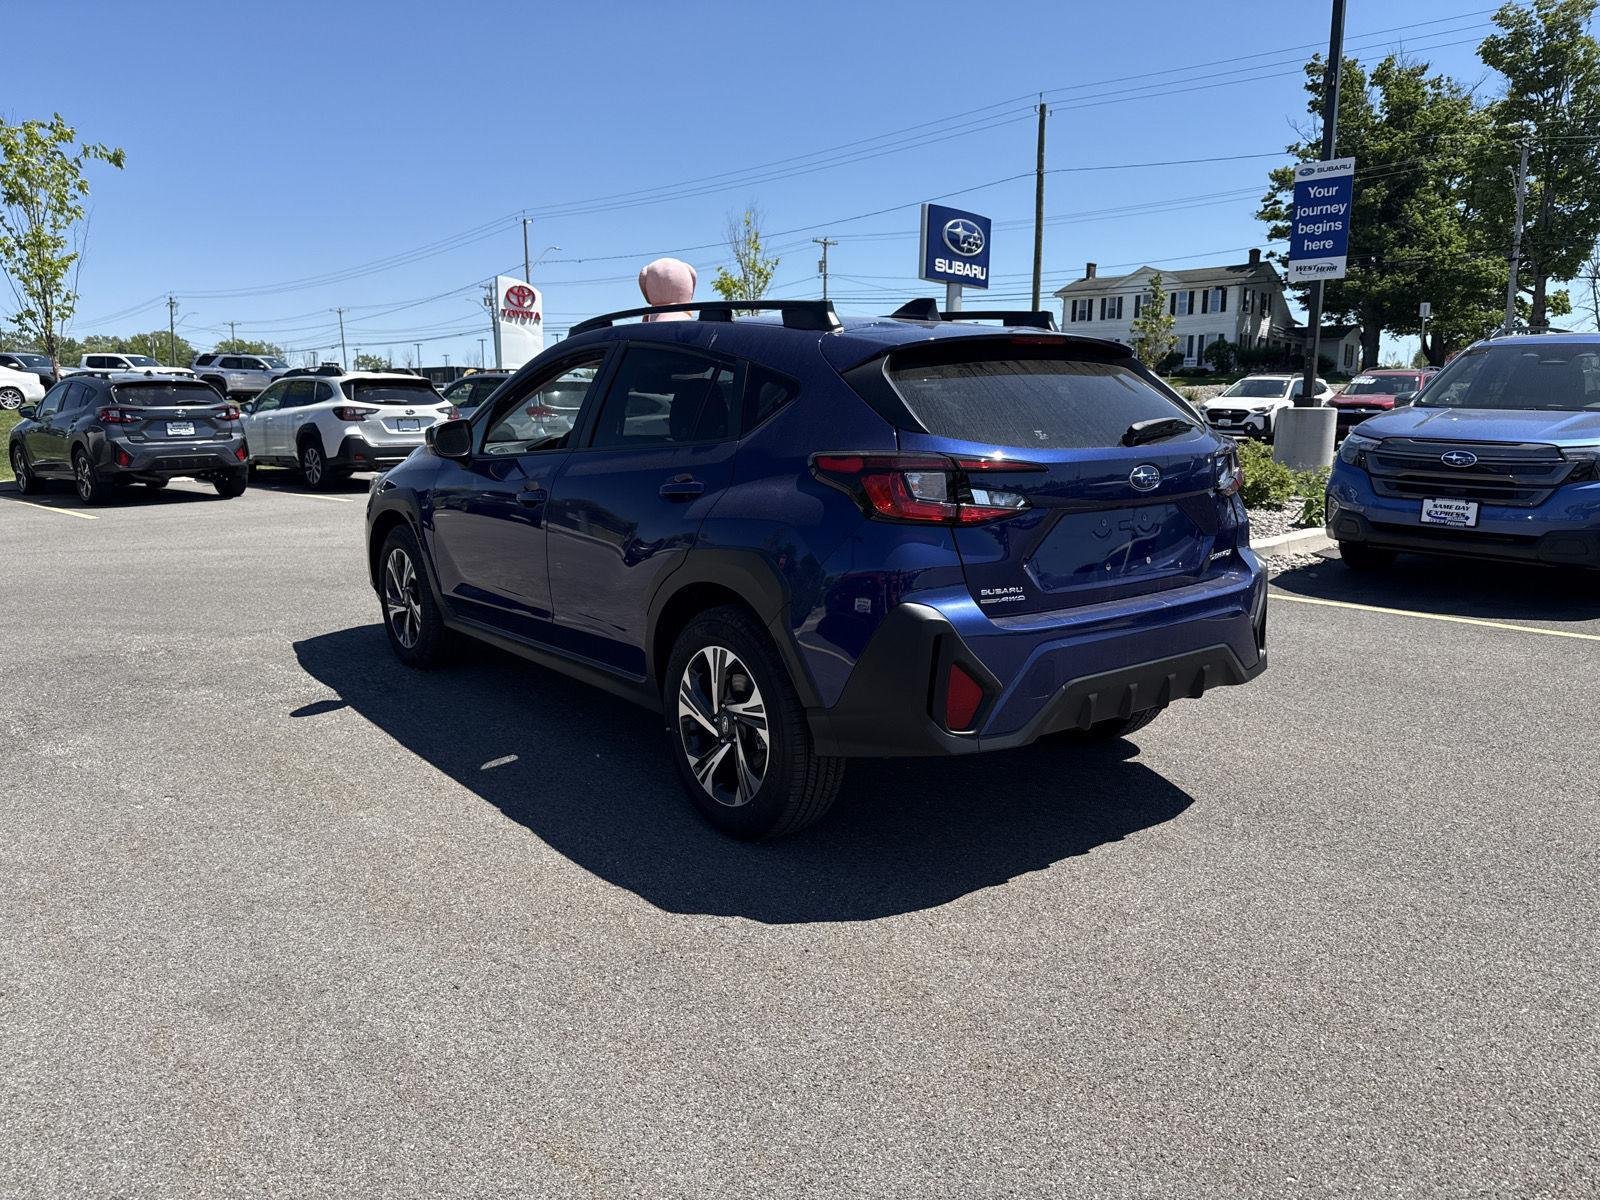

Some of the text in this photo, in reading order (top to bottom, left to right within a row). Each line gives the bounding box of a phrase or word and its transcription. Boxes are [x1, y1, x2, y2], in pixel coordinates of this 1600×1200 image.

[1317, 164, 1351, 173] SUBARU
[1308, 186, 1338, 198] Your
[1296, 203, 1347, 219] journey
[1298, 221, 1342, 235] begins
[1304, 239, 1333, 251] here
[935, 258, 986, 280] SUBARU
[501, 308, 541, 321] TOYOTA
[1429, 509, 1467, 518] EXPRESS
[981, 587, 1023, 595] SUBARU
